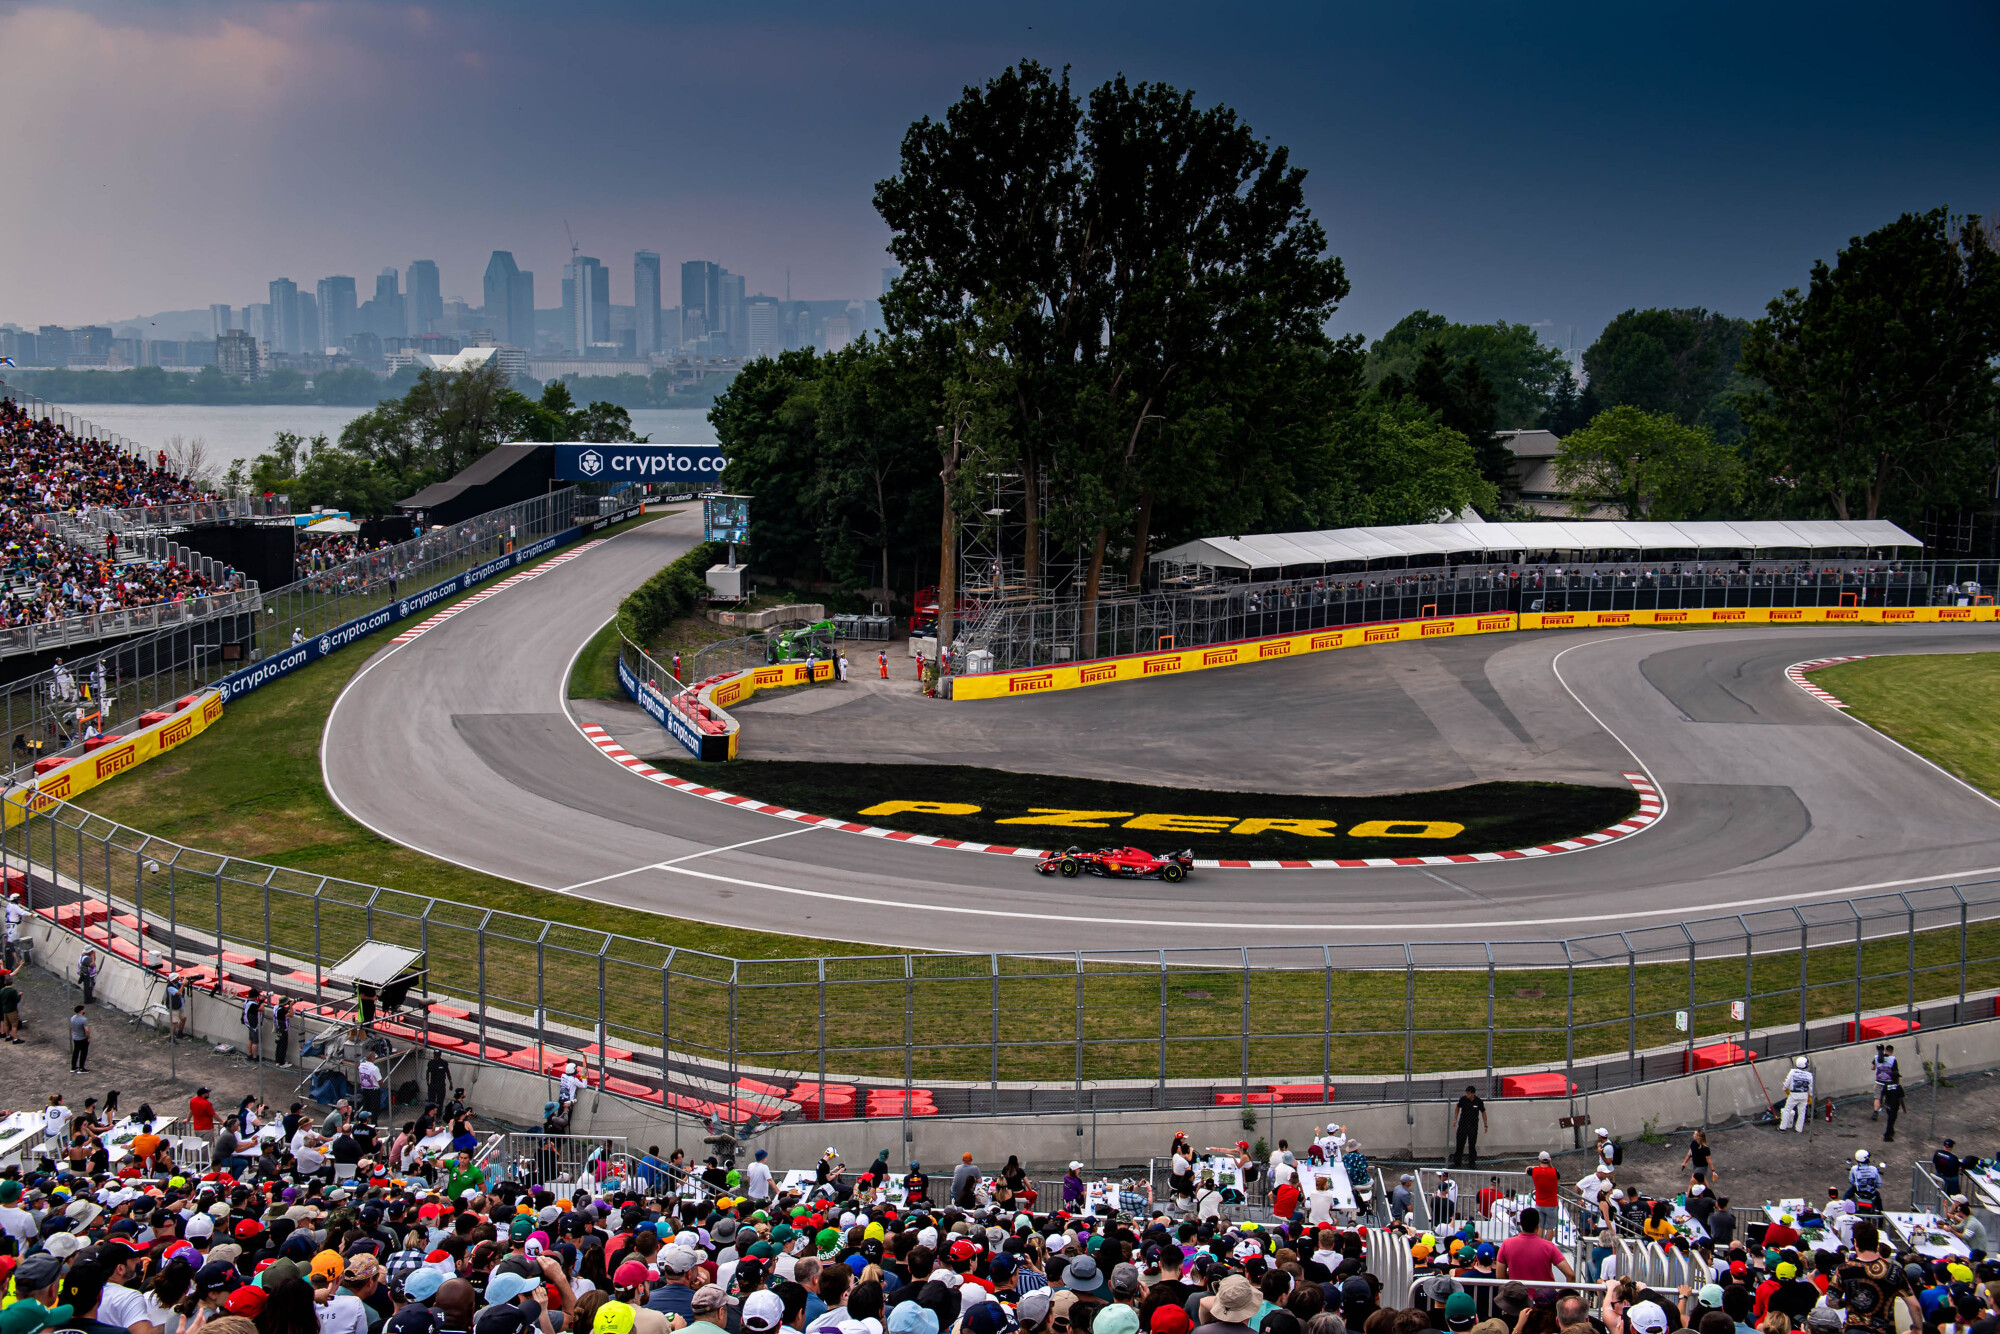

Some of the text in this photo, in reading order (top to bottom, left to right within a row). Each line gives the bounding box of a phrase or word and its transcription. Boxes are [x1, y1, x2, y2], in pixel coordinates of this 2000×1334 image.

[611, 453, 732, 475] crypto.co
[522, 538, 556, 559] crypto.com
[471, 557, 510, 582] crypto.com
[409, 582, 456, 610] crypto.com
[1542, 616, 1574, 624] PIRELLI
[1598, 614, 1630, 622] PIRELLI
[1655, 613, 1688, 621] PIRELLI
[1713, 611, 1745, 619] PIRELLI
[1770, 611, 1802, 619] PIRELLI
[1826, 611, 1858, 619] PIRELLI
[1882, 610, 1914, 618] PIRELLI
[1939, 610, 1971, 618] PIRELLI
[331, 611, 391, 647] crypto.com
[1421, 622, 1454, 635] PIRELLI
[1477, 618, 1510, 631] PIRELLI
[1311, 634, 1343, 649] PIRELLI
[1365, 627, 1399, 641] PIRELLI
[1260, 641, 1291, 657] PIRELLI
[1143, 657, 1181, 673] PIRELLI
[1203, 649, 1238, 666] PIRELLI
[232, 649, 307, 693] crypto.com
[795, 665, 829, 680] PIRLLI
[1080, 665, 1117, 683] PIRELLI
[1009, 674, 1053, 692] PIRELLI
[717, 683, 740, 706] PIRELLI
[642, 693, 665, 722] crypto.com
[160, 717, 192, 749] PIRELLI
[673, 721, 699, 754] crypto.com
[96, 744, 135, 779] PIRELLI
